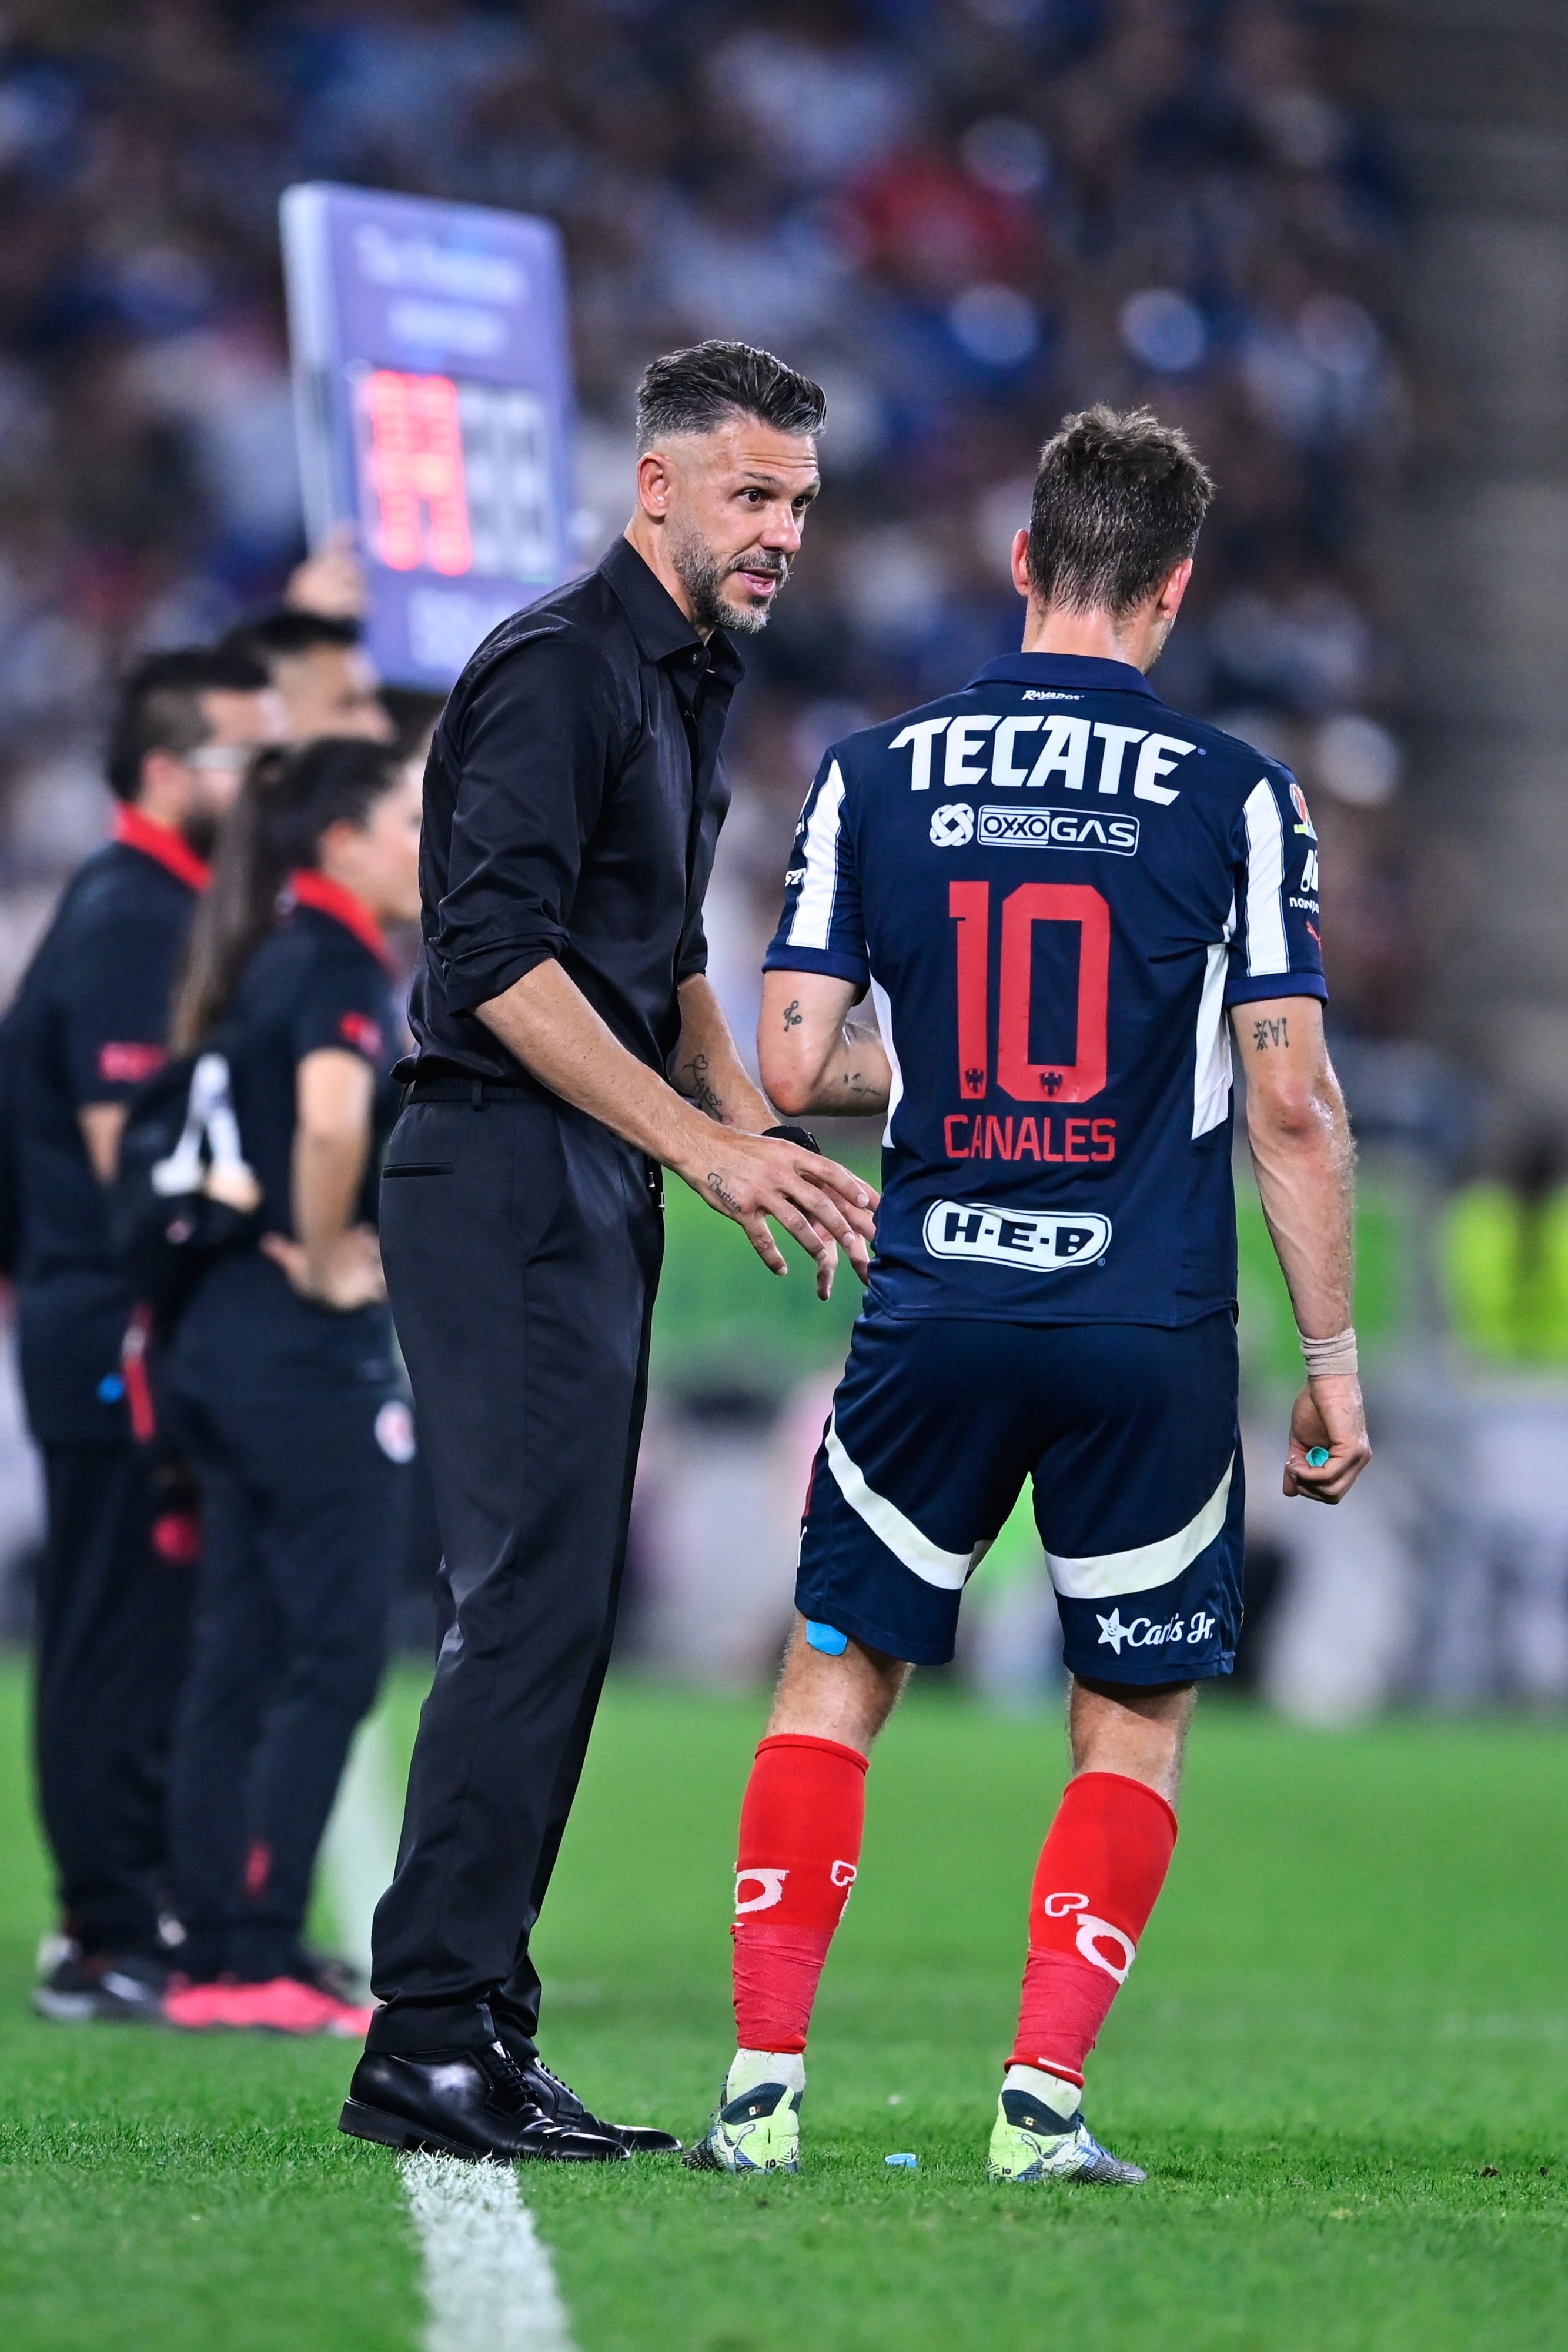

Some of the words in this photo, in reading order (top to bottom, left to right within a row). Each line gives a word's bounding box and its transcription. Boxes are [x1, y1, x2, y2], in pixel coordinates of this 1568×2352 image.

[888, 714, 1197, 806] TECATE
[949, 881, 1111, 1103] 10
[944, 1114, 1116, 1162] CANALES
